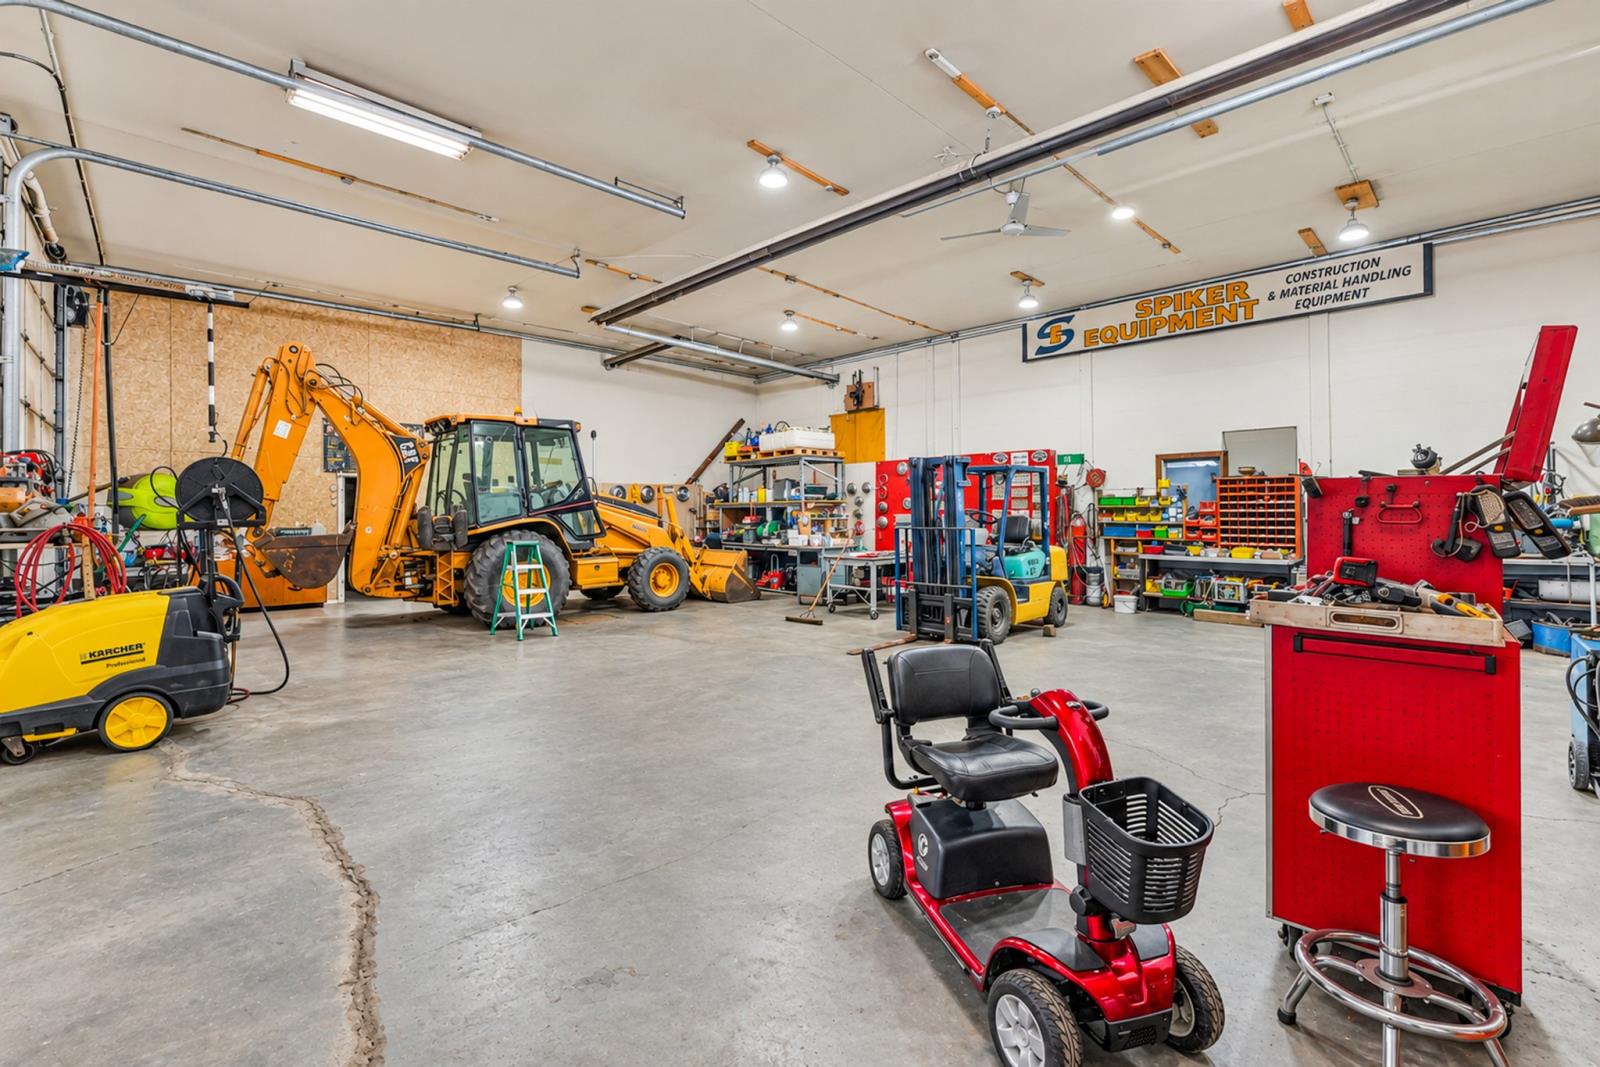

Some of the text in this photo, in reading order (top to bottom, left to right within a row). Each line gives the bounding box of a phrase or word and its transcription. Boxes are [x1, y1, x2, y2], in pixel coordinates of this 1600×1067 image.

[1267, 265, 1412, 301] & MATERIAL HANDLING
[1285, 257, 1381, 284] CONSTRUCTION
[1135, 281, 1250, 319] SPIKER
[1295, 287, 1370, 310] EQUIPMENT
[1084, 299, 1259, 348] EQUIPMENT
